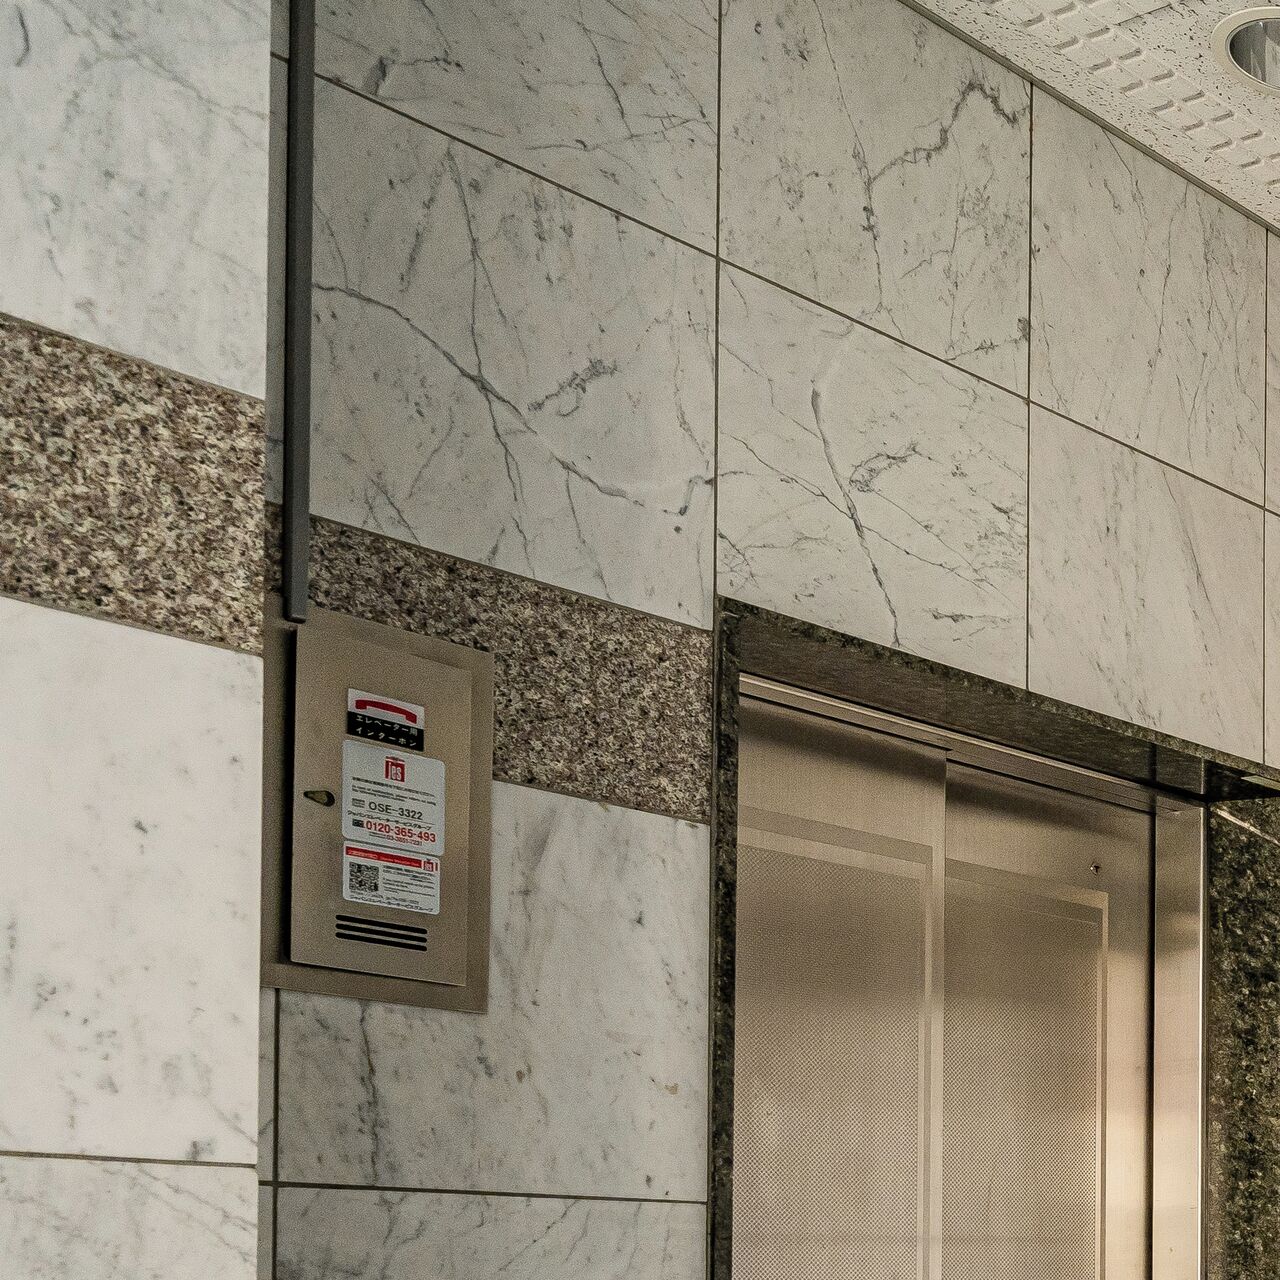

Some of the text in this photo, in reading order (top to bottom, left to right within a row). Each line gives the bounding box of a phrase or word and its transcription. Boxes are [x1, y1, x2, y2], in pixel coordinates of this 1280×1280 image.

[355, 714, 418, 736] エレベーター用
[355, 726, 417, 747] インターホン
[368, 801, 423, 820] OSE-3322
[365, 820, 436, 843] 0120-365-493
